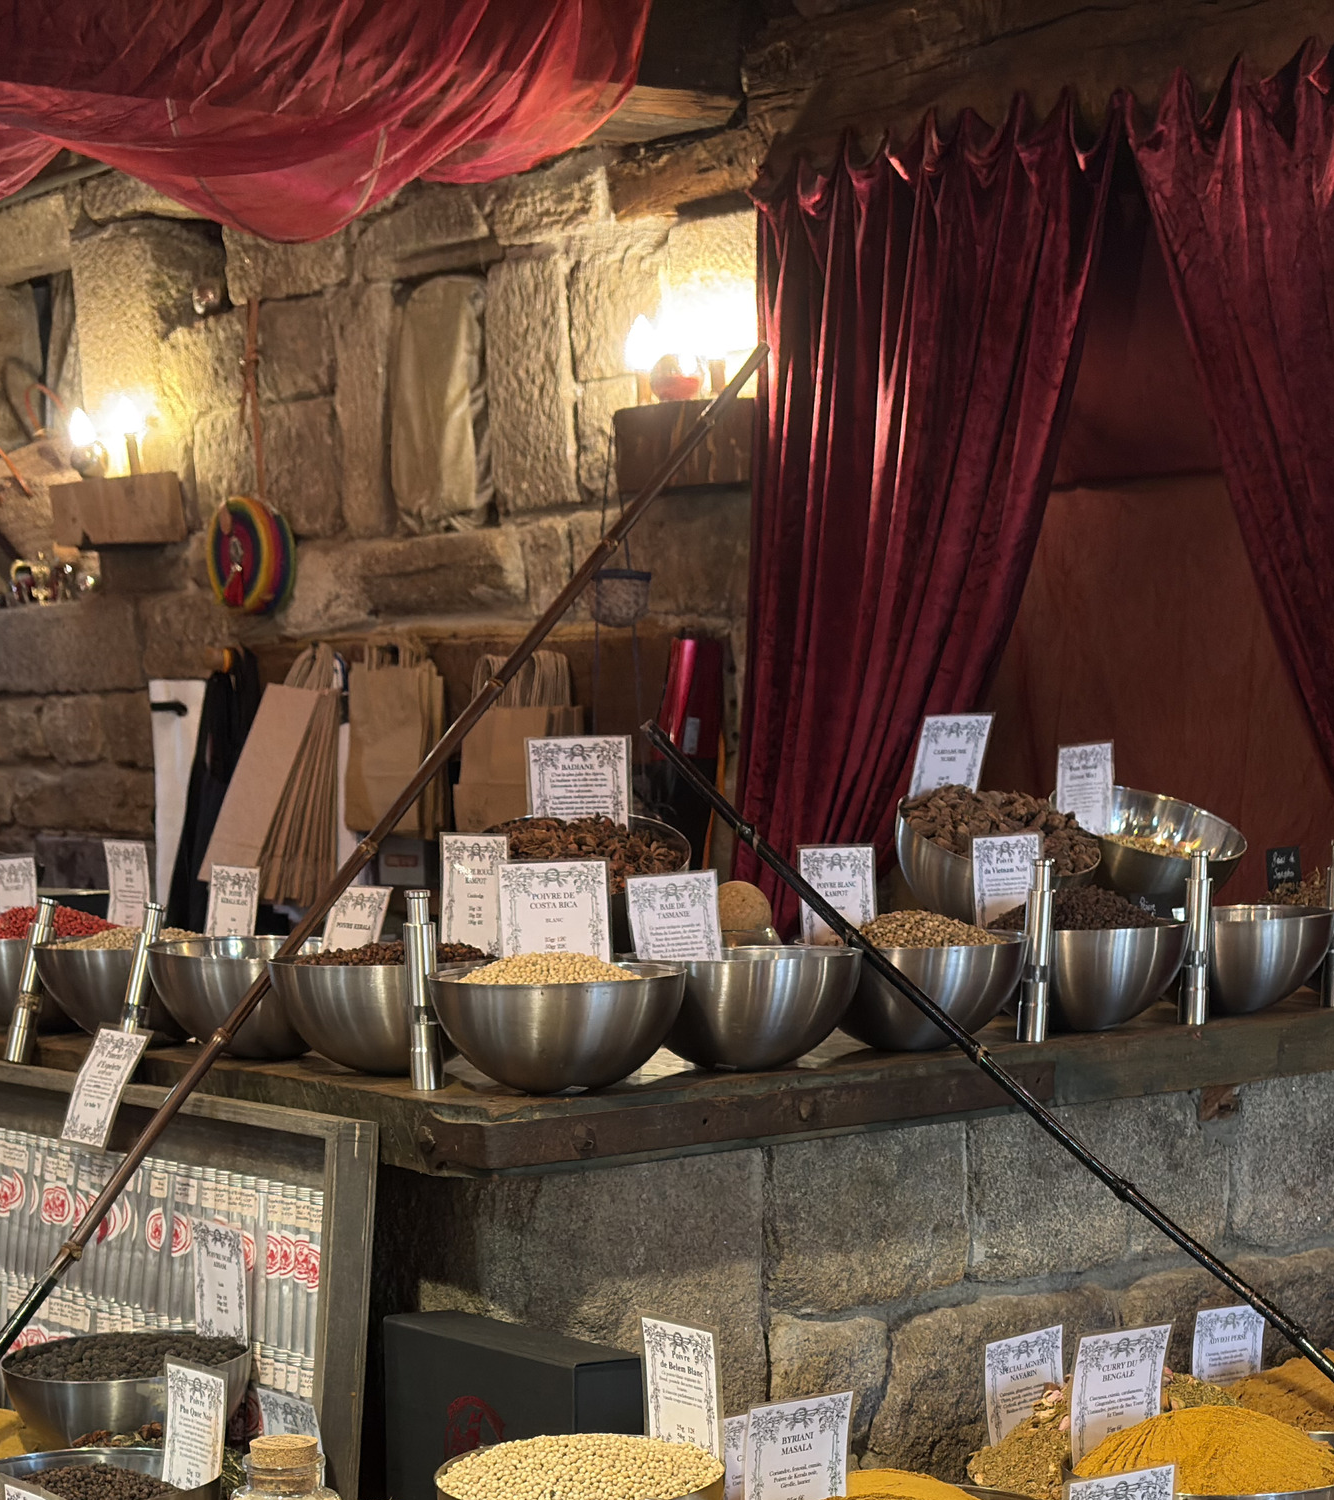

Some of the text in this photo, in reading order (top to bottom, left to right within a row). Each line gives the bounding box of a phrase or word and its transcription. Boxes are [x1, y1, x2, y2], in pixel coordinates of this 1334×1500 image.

[671, 1350, 690, 1363] Poivre
[660, 1360, 668, 1368] de
[668, 1362, 686, 1374] Belem
[1102, 1361, 1126, 1373] CURRY
[1102, 1370, 1135, 1382] BENGALE
[782, 1431, 814, 1445] BYRIANI
[781, 1443, 812, 1456] MASALA
